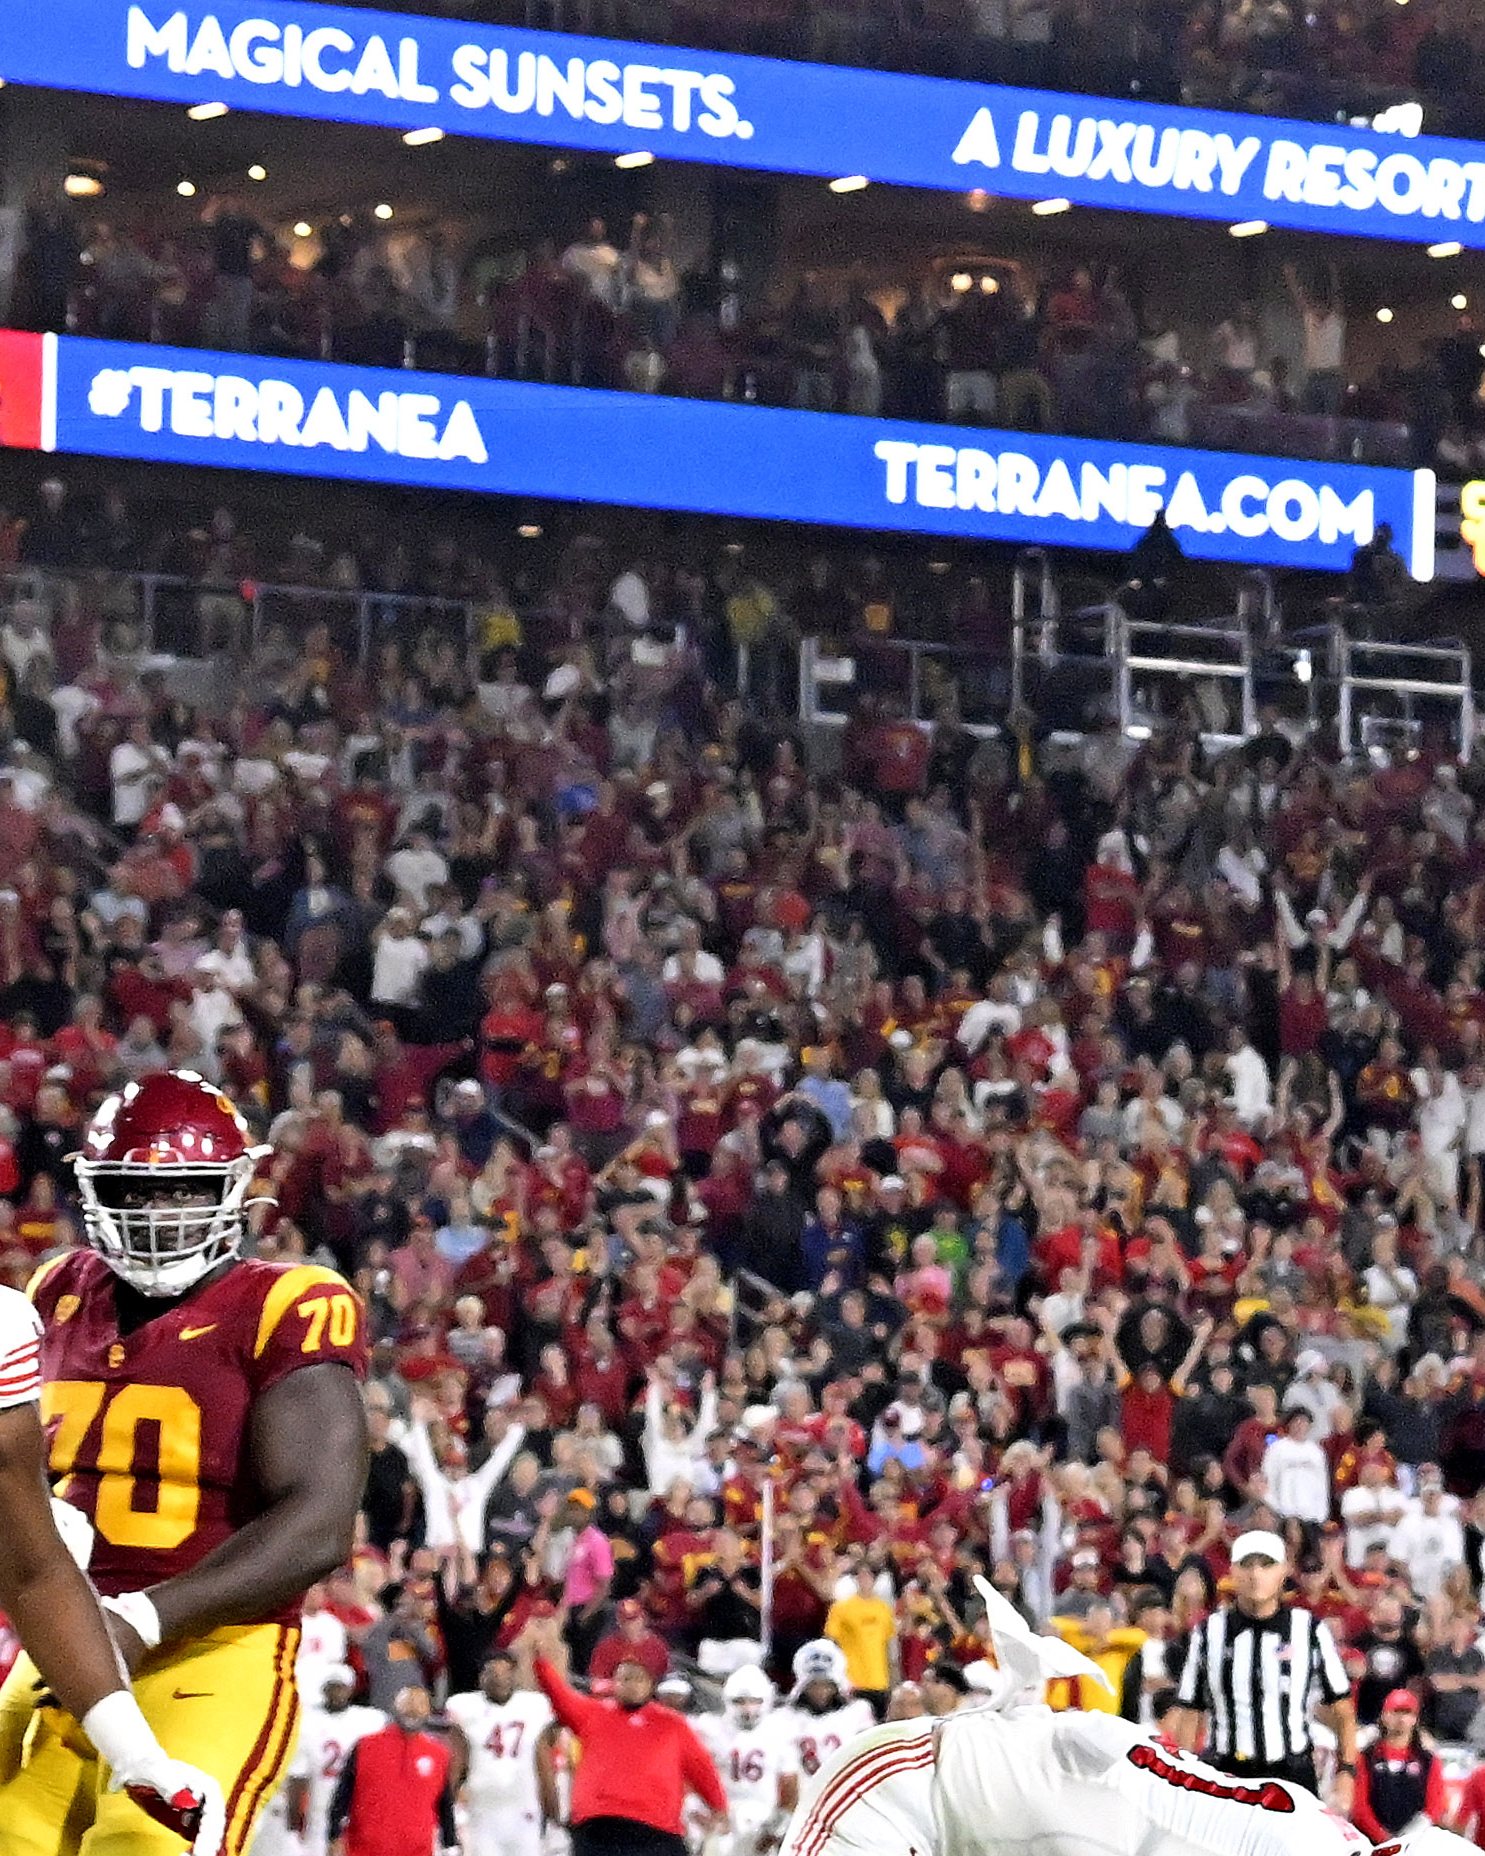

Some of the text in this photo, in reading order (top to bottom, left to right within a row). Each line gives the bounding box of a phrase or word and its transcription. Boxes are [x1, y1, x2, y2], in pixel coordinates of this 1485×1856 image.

[127, 7, 754, 139] MAGICAL SUNSETS.
[952, 107, 1001, 168] A
[1011, 111, 1261, 196] LUXURY
[88, 366, 488, 464] #TERRANEA
[298, 1293, 356, 1353] 70
[41, 1381, 202, 1549] 70
[483, 1720, 525, 1759] 47
[731, 1749, 764, 1783] 16
